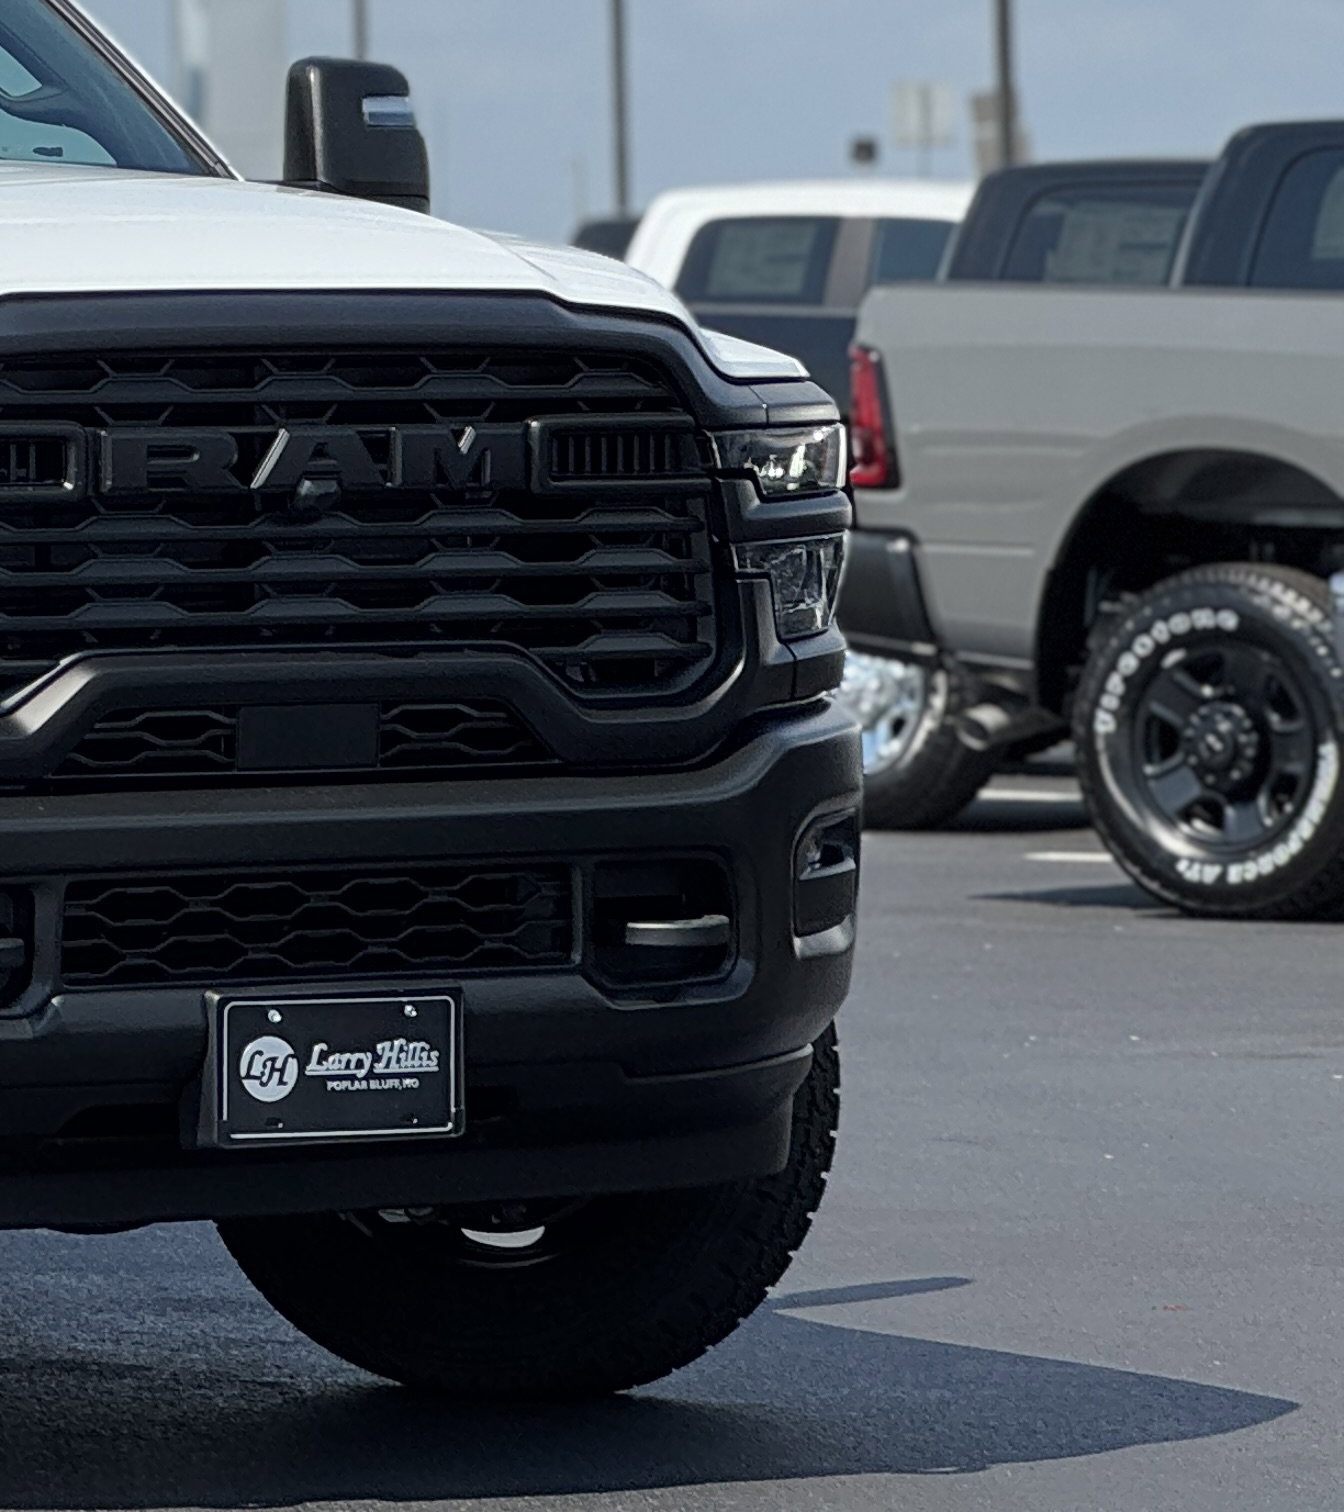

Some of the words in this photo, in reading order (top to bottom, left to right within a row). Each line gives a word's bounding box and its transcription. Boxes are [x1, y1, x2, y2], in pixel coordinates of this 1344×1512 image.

[101, 425, 526, 489] RAM
[305, 1042, 373, 1078] Larry
[373, 1039, 440, 1072] Hillis
[326, 1079, 368, 1091] POPLAR
